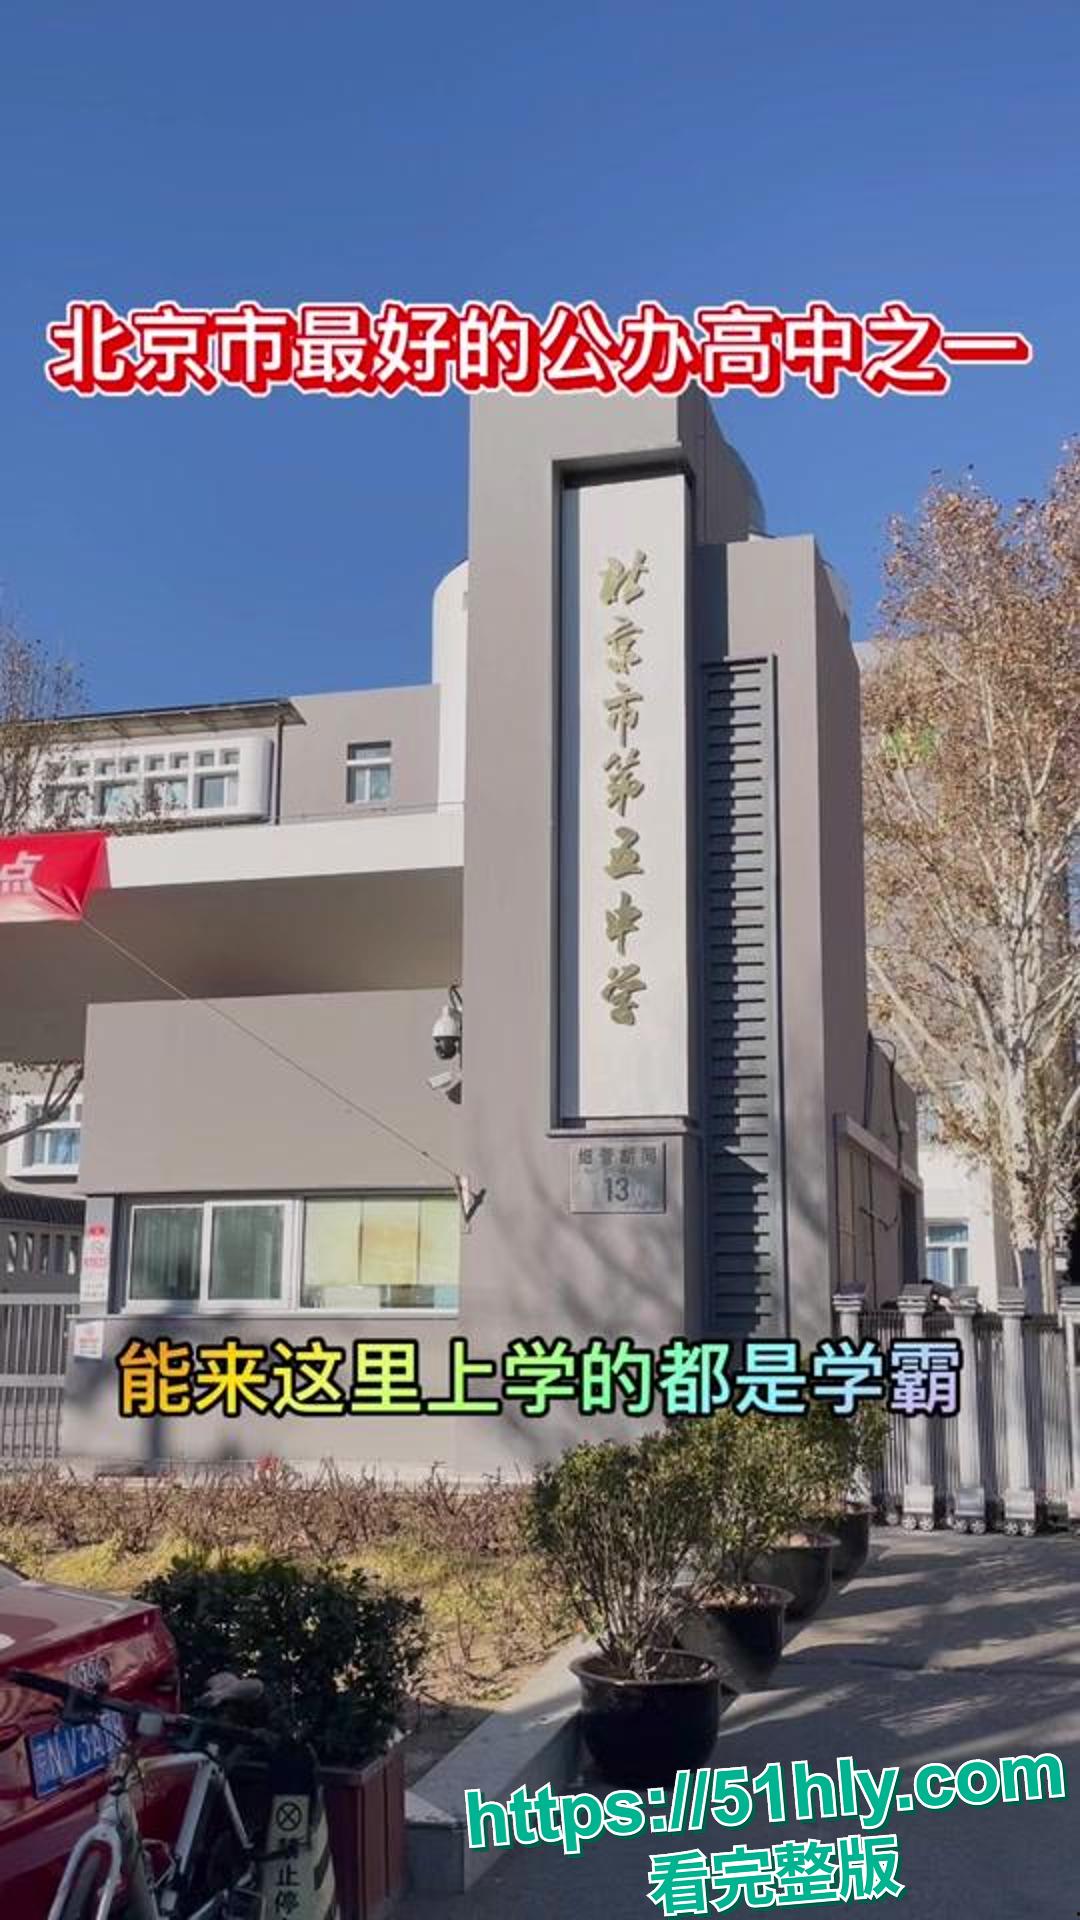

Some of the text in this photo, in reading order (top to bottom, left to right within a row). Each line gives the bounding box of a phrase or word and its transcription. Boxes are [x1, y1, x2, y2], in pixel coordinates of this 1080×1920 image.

[600, 549, 648, 1026] 北京市第五中学
[604, 1177, 629, 1202] 13
